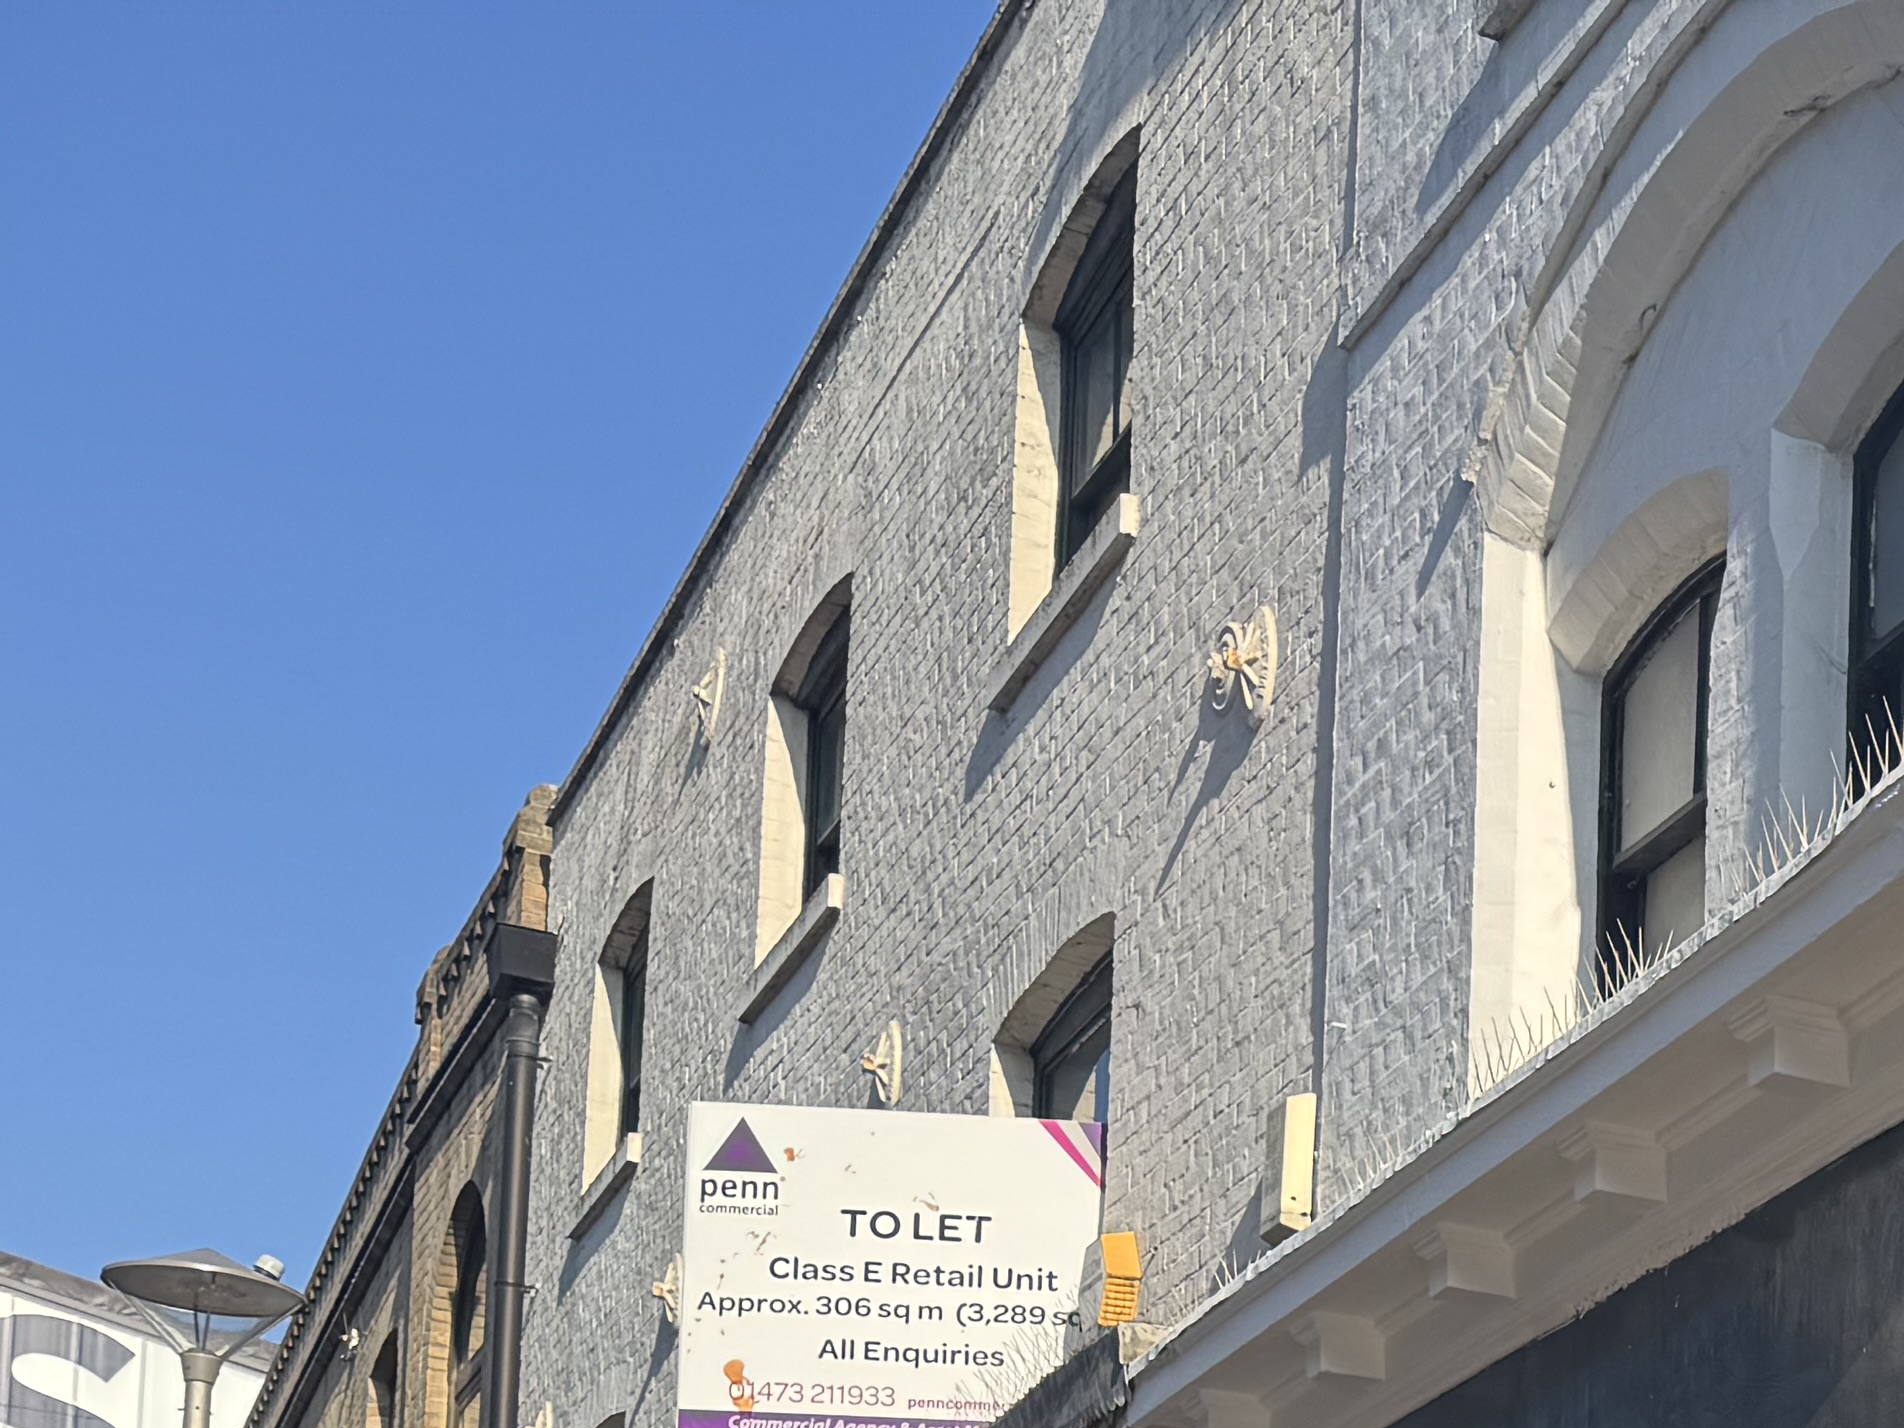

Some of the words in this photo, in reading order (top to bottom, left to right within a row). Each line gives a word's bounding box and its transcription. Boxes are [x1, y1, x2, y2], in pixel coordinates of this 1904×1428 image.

[700, 1178, 779, 1203] penn
[699, 1204, 779, 1216] commercial
[840, 1209, 900, 1240] TO
[912, 1212, 992, 1244] LET
[768, 1256, 854, 1283] Class
[863, 1261, 883, 1284] E
[891, 1261, 983, 1288] Retail
[993, 1265, 1059, 1292] Unit
[697, 1290, 808, 1318] Approx.
[815, 1296, 871, 1318] 306
[878, 1302, 911, 1325] sq
[918, 1304, 943, 1322] m
[956, 1302, 1046, 1328] (3,289
[1051, 1310, 1083, 1332] sq
[818, 1338, 855, 1360] All
[864, 1340, 1005, 1370] Enquiries
[728, 1381, 804, 1405] 01473
[810, 1382, 895, 1407] 211933
